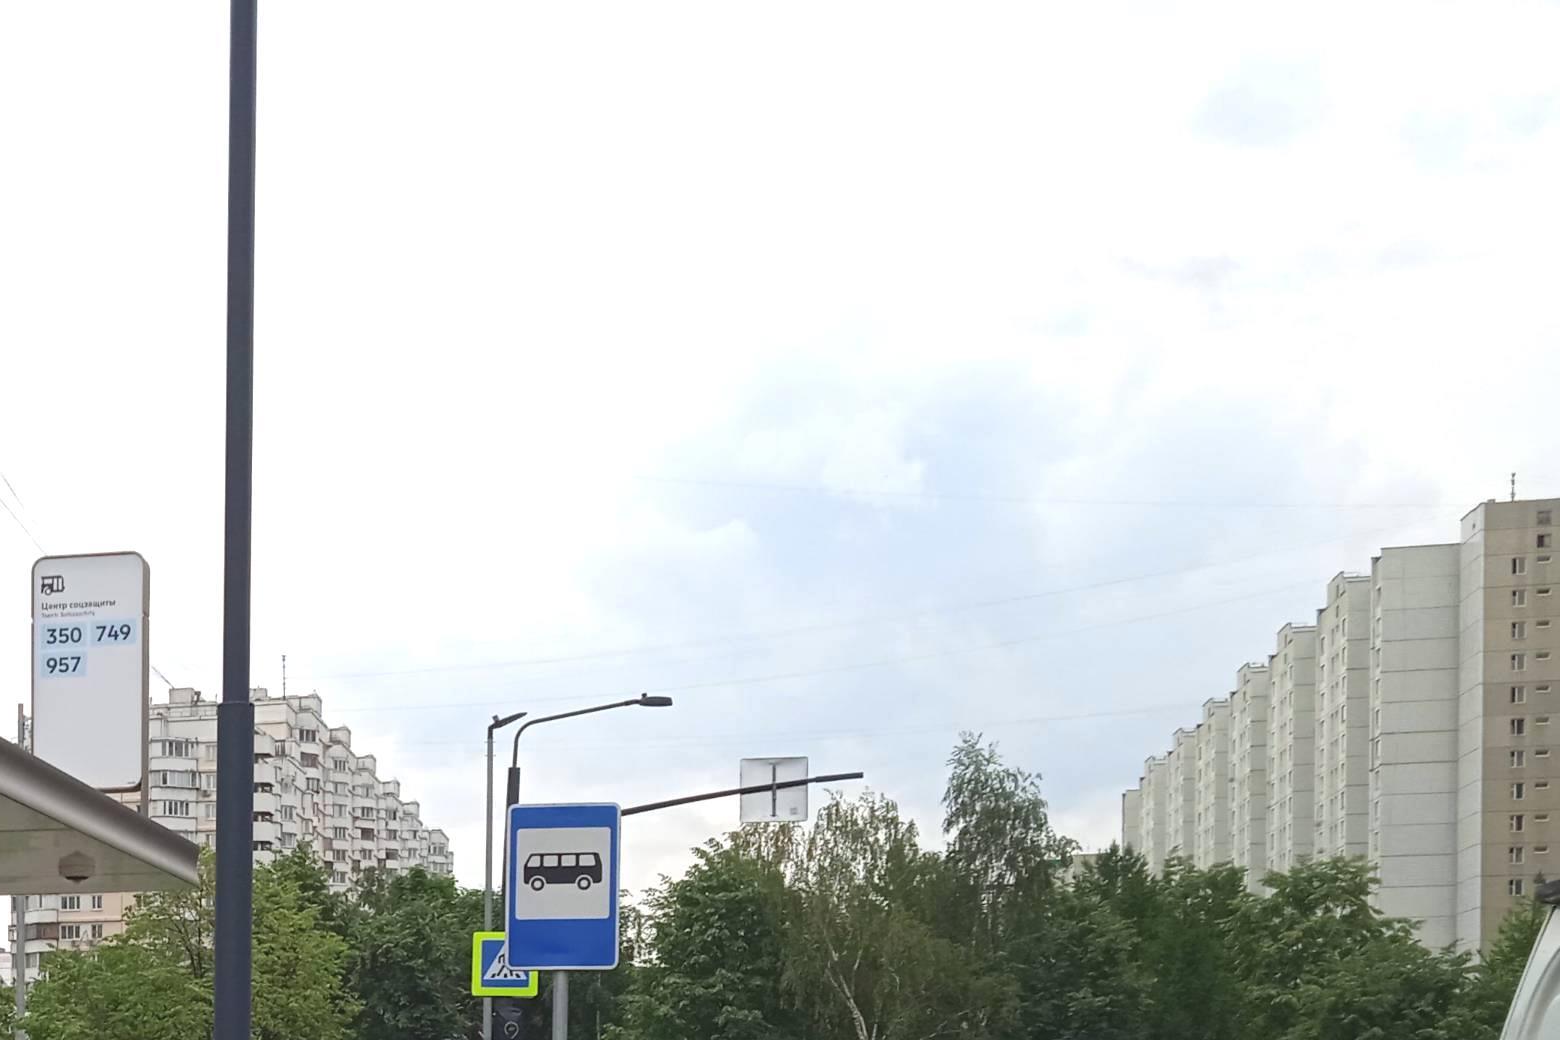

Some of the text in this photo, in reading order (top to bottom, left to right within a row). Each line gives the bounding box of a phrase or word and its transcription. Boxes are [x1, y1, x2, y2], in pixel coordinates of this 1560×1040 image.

[41, 602, 68, 611] Центр
[46, 624, 132, 645] 350 749
[46, 656, 82, 674] 957
